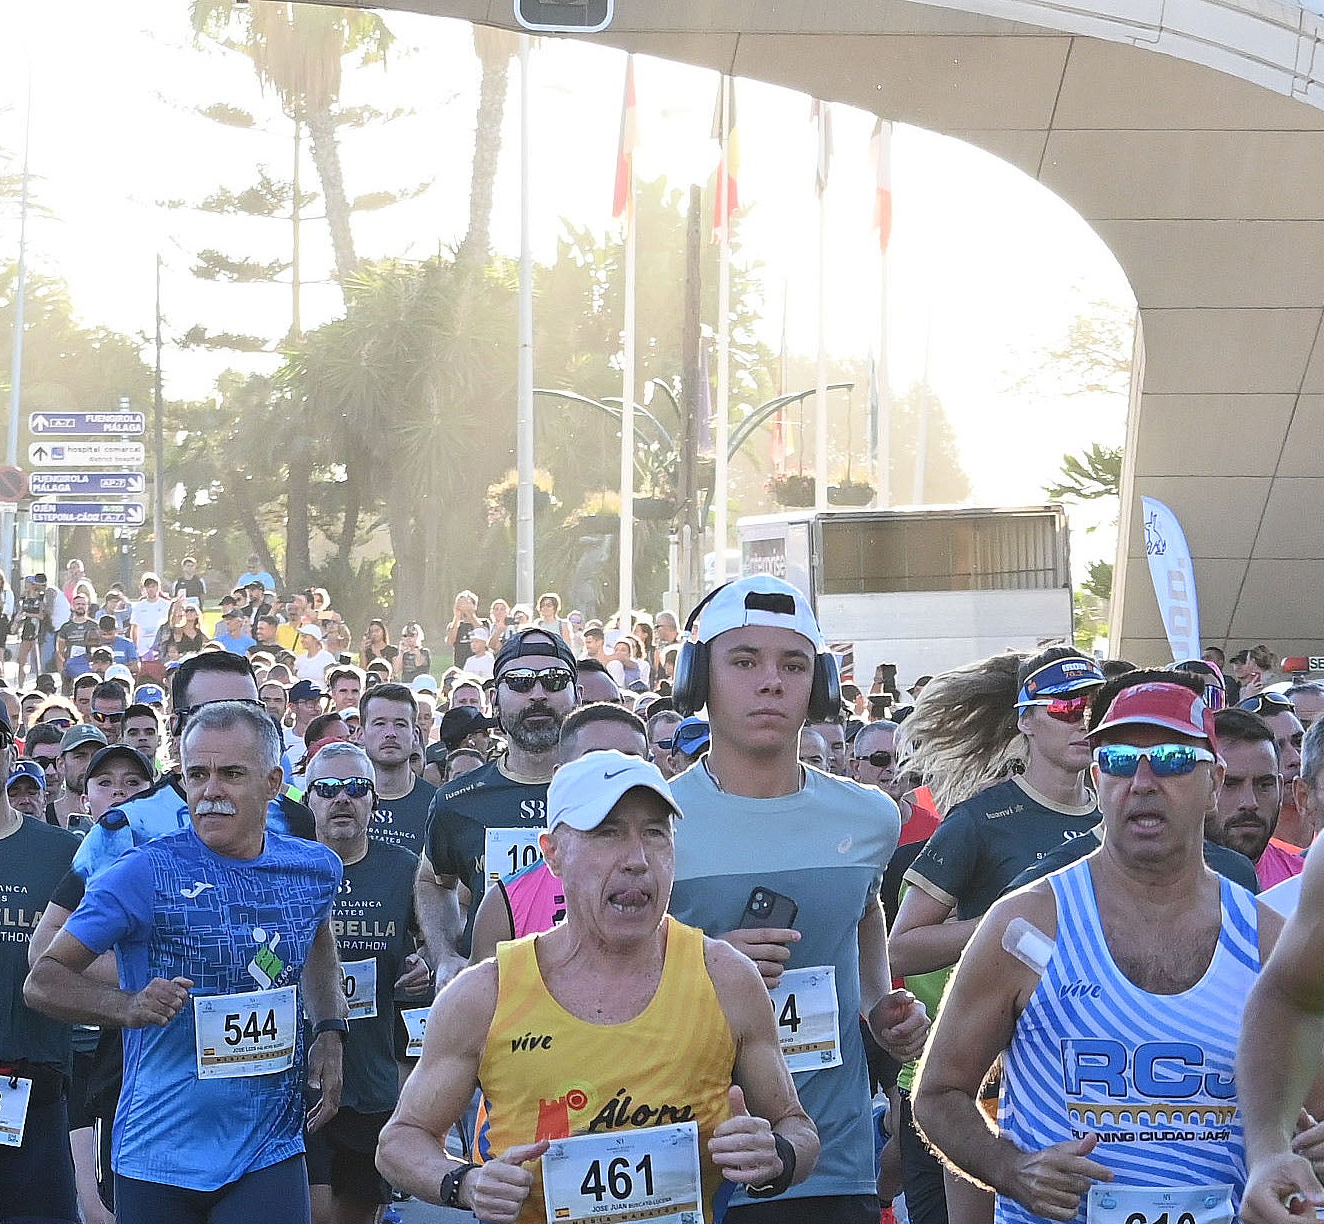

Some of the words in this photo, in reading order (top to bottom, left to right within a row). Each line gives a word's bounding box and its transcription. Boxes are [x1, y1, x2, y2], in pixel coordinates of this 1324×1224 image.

[86, 415, 142, 423] FUENGIROLA
[104, 423, 142, 431] MÁLAGA
[33, 483, 71, 491] MÁLAGA
[34, 503, 56, 512] OJÉN
[507, 844, 544, 876] 10
[334, 921, 396, 937] BELLA
[771, 994, 801, 1033] 4
[224, 1009, 277, 1046] 544
[1139, 1130, 1196, 1142] CIUDAD
[580, 1154, 654, 1202] 461
[592, 1205, 608, 1213] JOSE
[610, 1203, 627, 1211] JUAN
